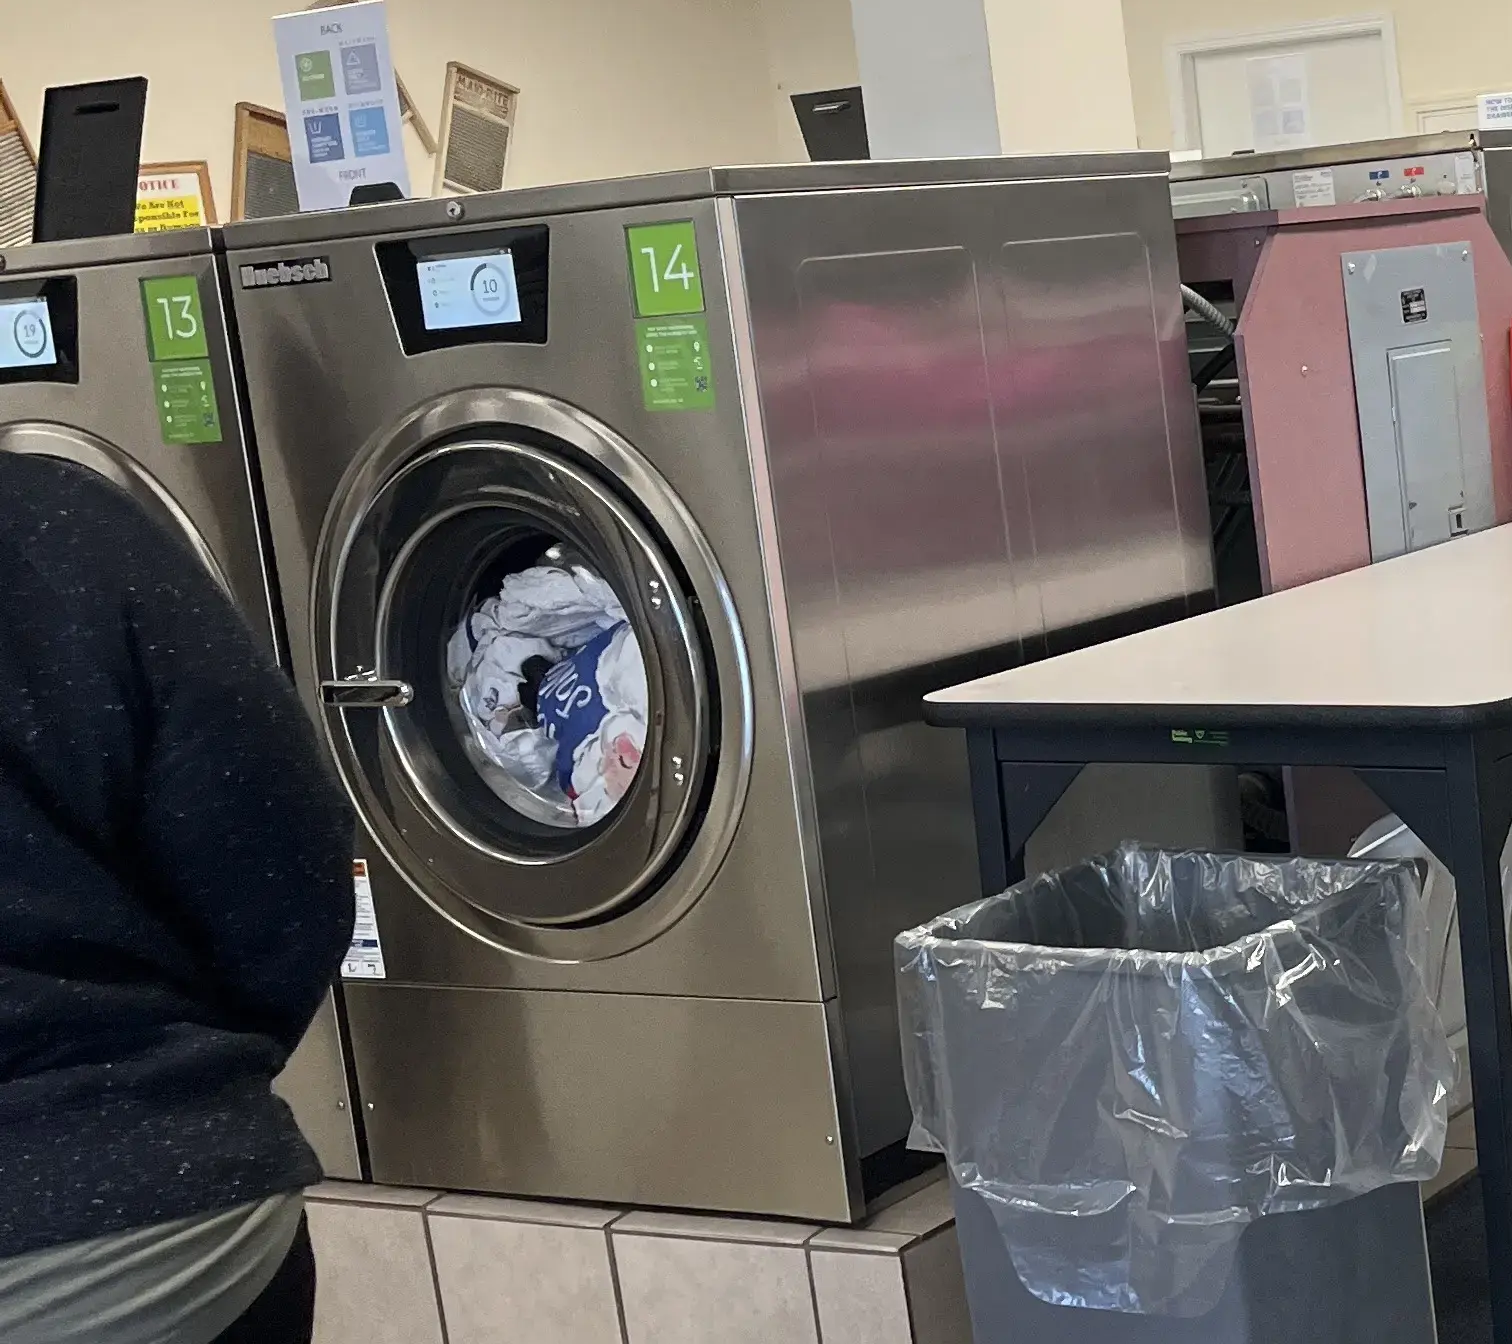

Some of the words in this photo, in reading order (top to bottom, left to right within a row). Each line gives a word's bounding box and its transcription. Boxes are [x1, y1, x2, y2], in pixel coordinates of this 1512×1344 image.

[320, 23, 343, 36] BACK
[139, 179, 179, 191] OTICE
[240, 259, 329, 286] Huebsch
[641, 244, 694, 293] 14
[482, 279, 498, 294] 10
[157, 295, 197, 340] 13
[23, 324, 36, 338] 19
